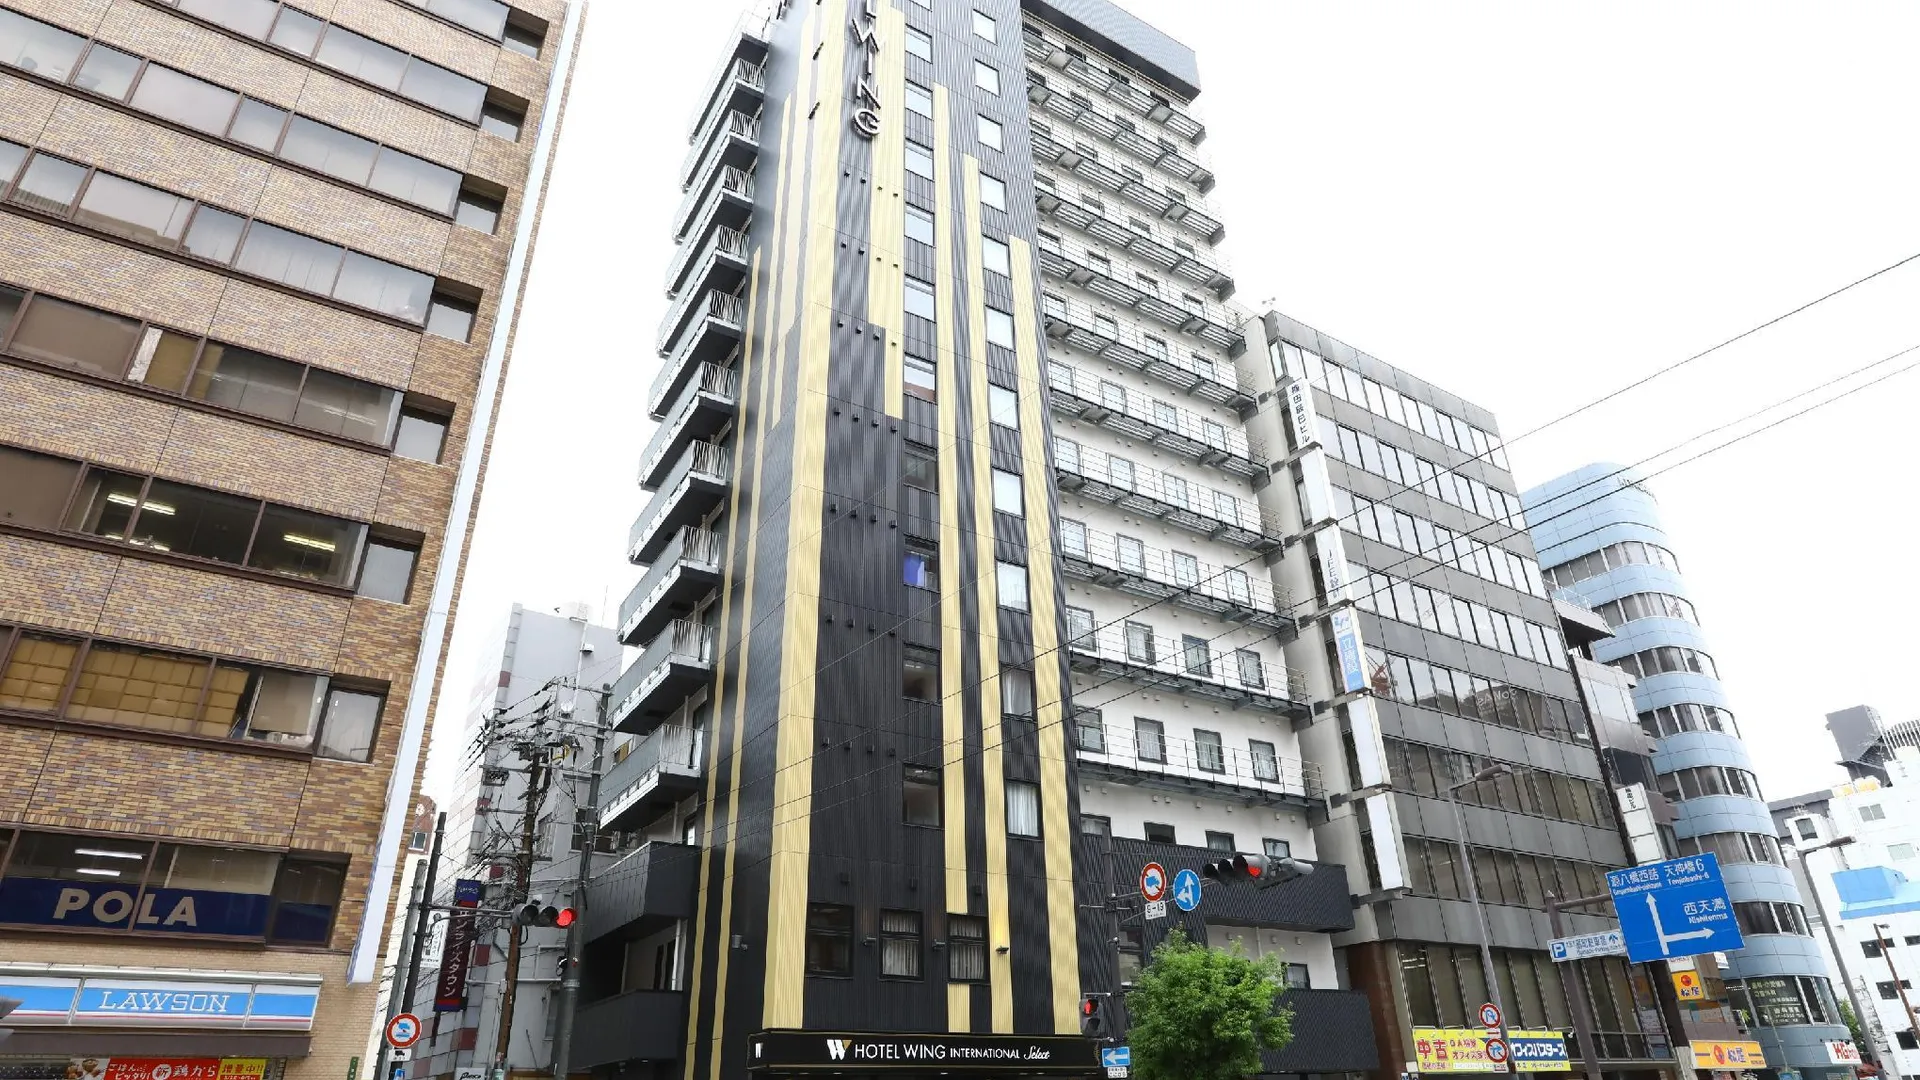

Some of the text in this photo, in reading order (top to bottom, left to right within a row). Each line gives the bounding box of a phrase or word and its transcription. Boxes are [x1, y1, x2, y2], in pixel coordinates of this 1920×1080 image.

[852, 18, 882, 135] WING
[1664, 858, 1705, 878] 天神橋6
[53, 887, 198, 927] POLA
[1683, 897, 1727, 916] 西天満
[99, 991, 230, 1013] LAWSON
[1680, 986, 1700, 998] 松屋
[854, 1044, 900, 1059] HOTEL
[903, 1044, 946, 1060] WING
[950, 1047, 1020, 1059] INTERNATIONAL
[1023, 1045, 1050, 1060] Select
[1416, 1038, 1449, 1060] 中古
[1727, 1047, 1746, 1063] 松屋
